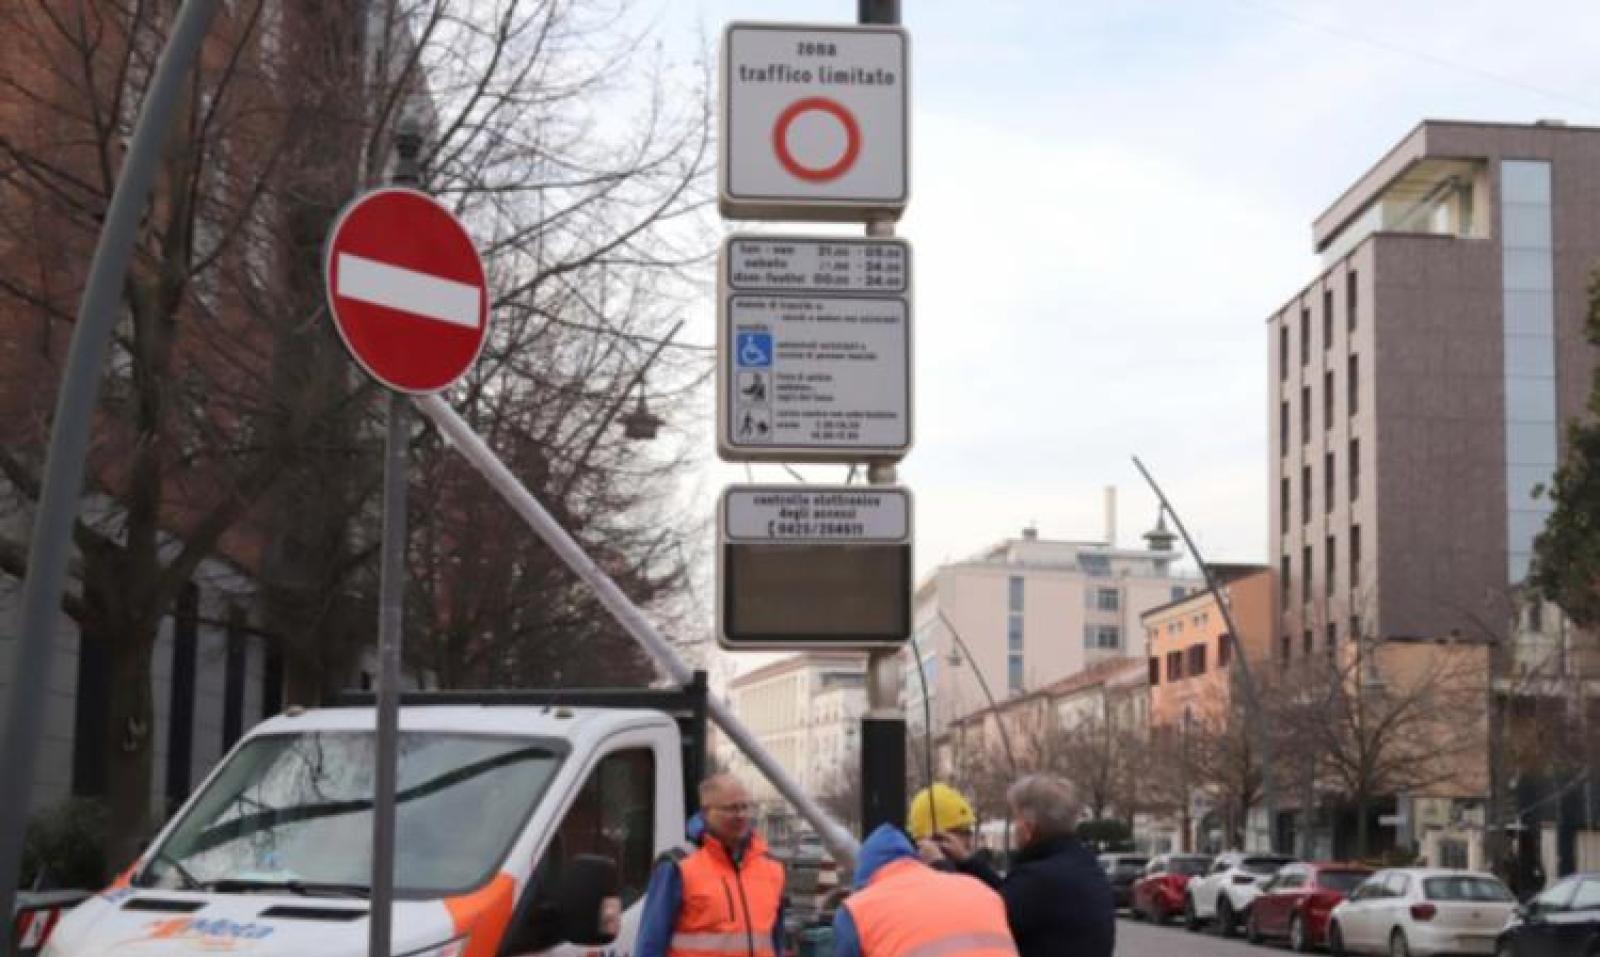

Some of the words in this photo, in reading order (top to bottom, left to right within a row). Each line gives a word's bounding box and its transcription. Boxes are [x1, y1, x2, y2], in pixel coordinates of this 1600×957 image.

[797, 41, 837, 57] zona
[739, 63, 812, 83] traffico
[819, 65, 895, 86] limitato
[753, 494, 809, 506] controllo
[779, 506, 809, 520] degli
